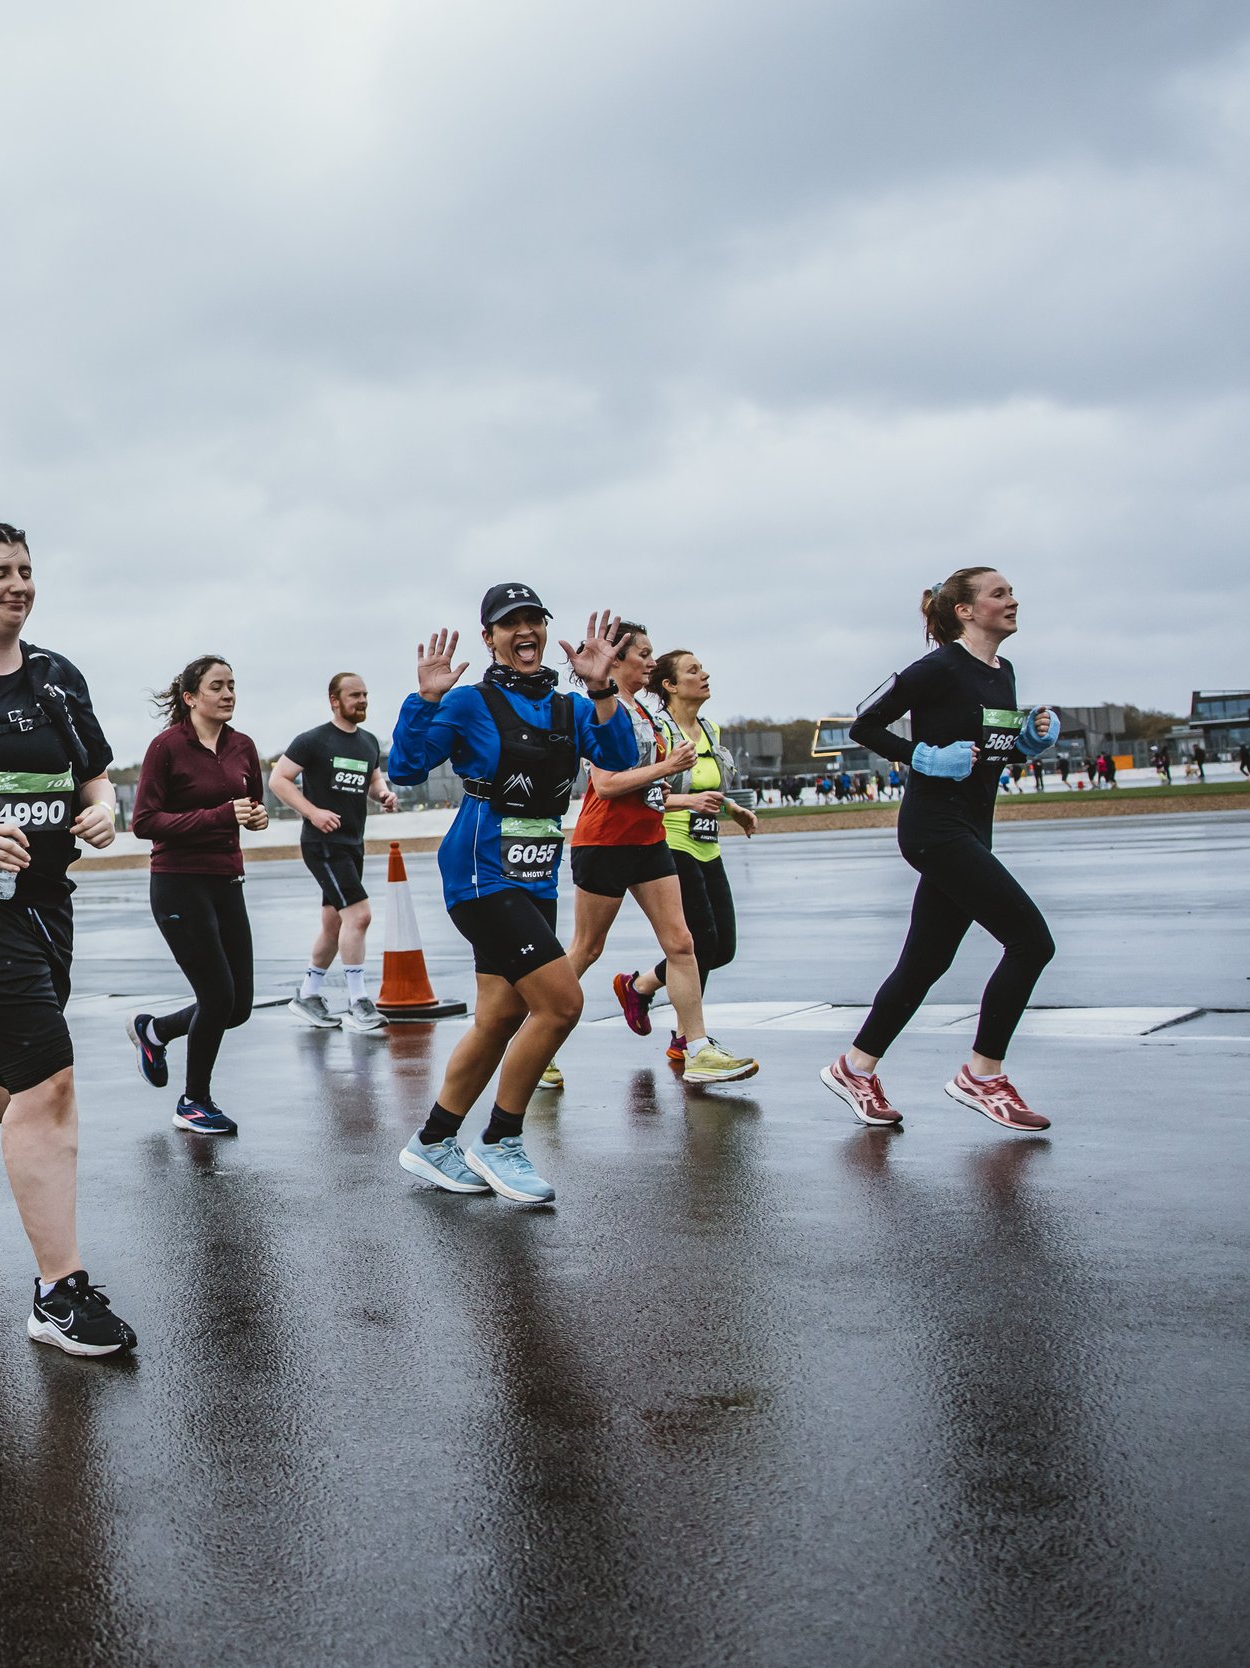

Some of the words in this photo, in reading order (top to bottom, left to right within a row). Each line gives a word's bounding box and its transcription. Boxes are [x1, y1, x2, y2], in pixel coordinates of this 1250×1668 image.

[335, 771, 366, 786] 6279
[507, 844, 557, 864] 6055
[522, 870, 545, 878] AHOTU
